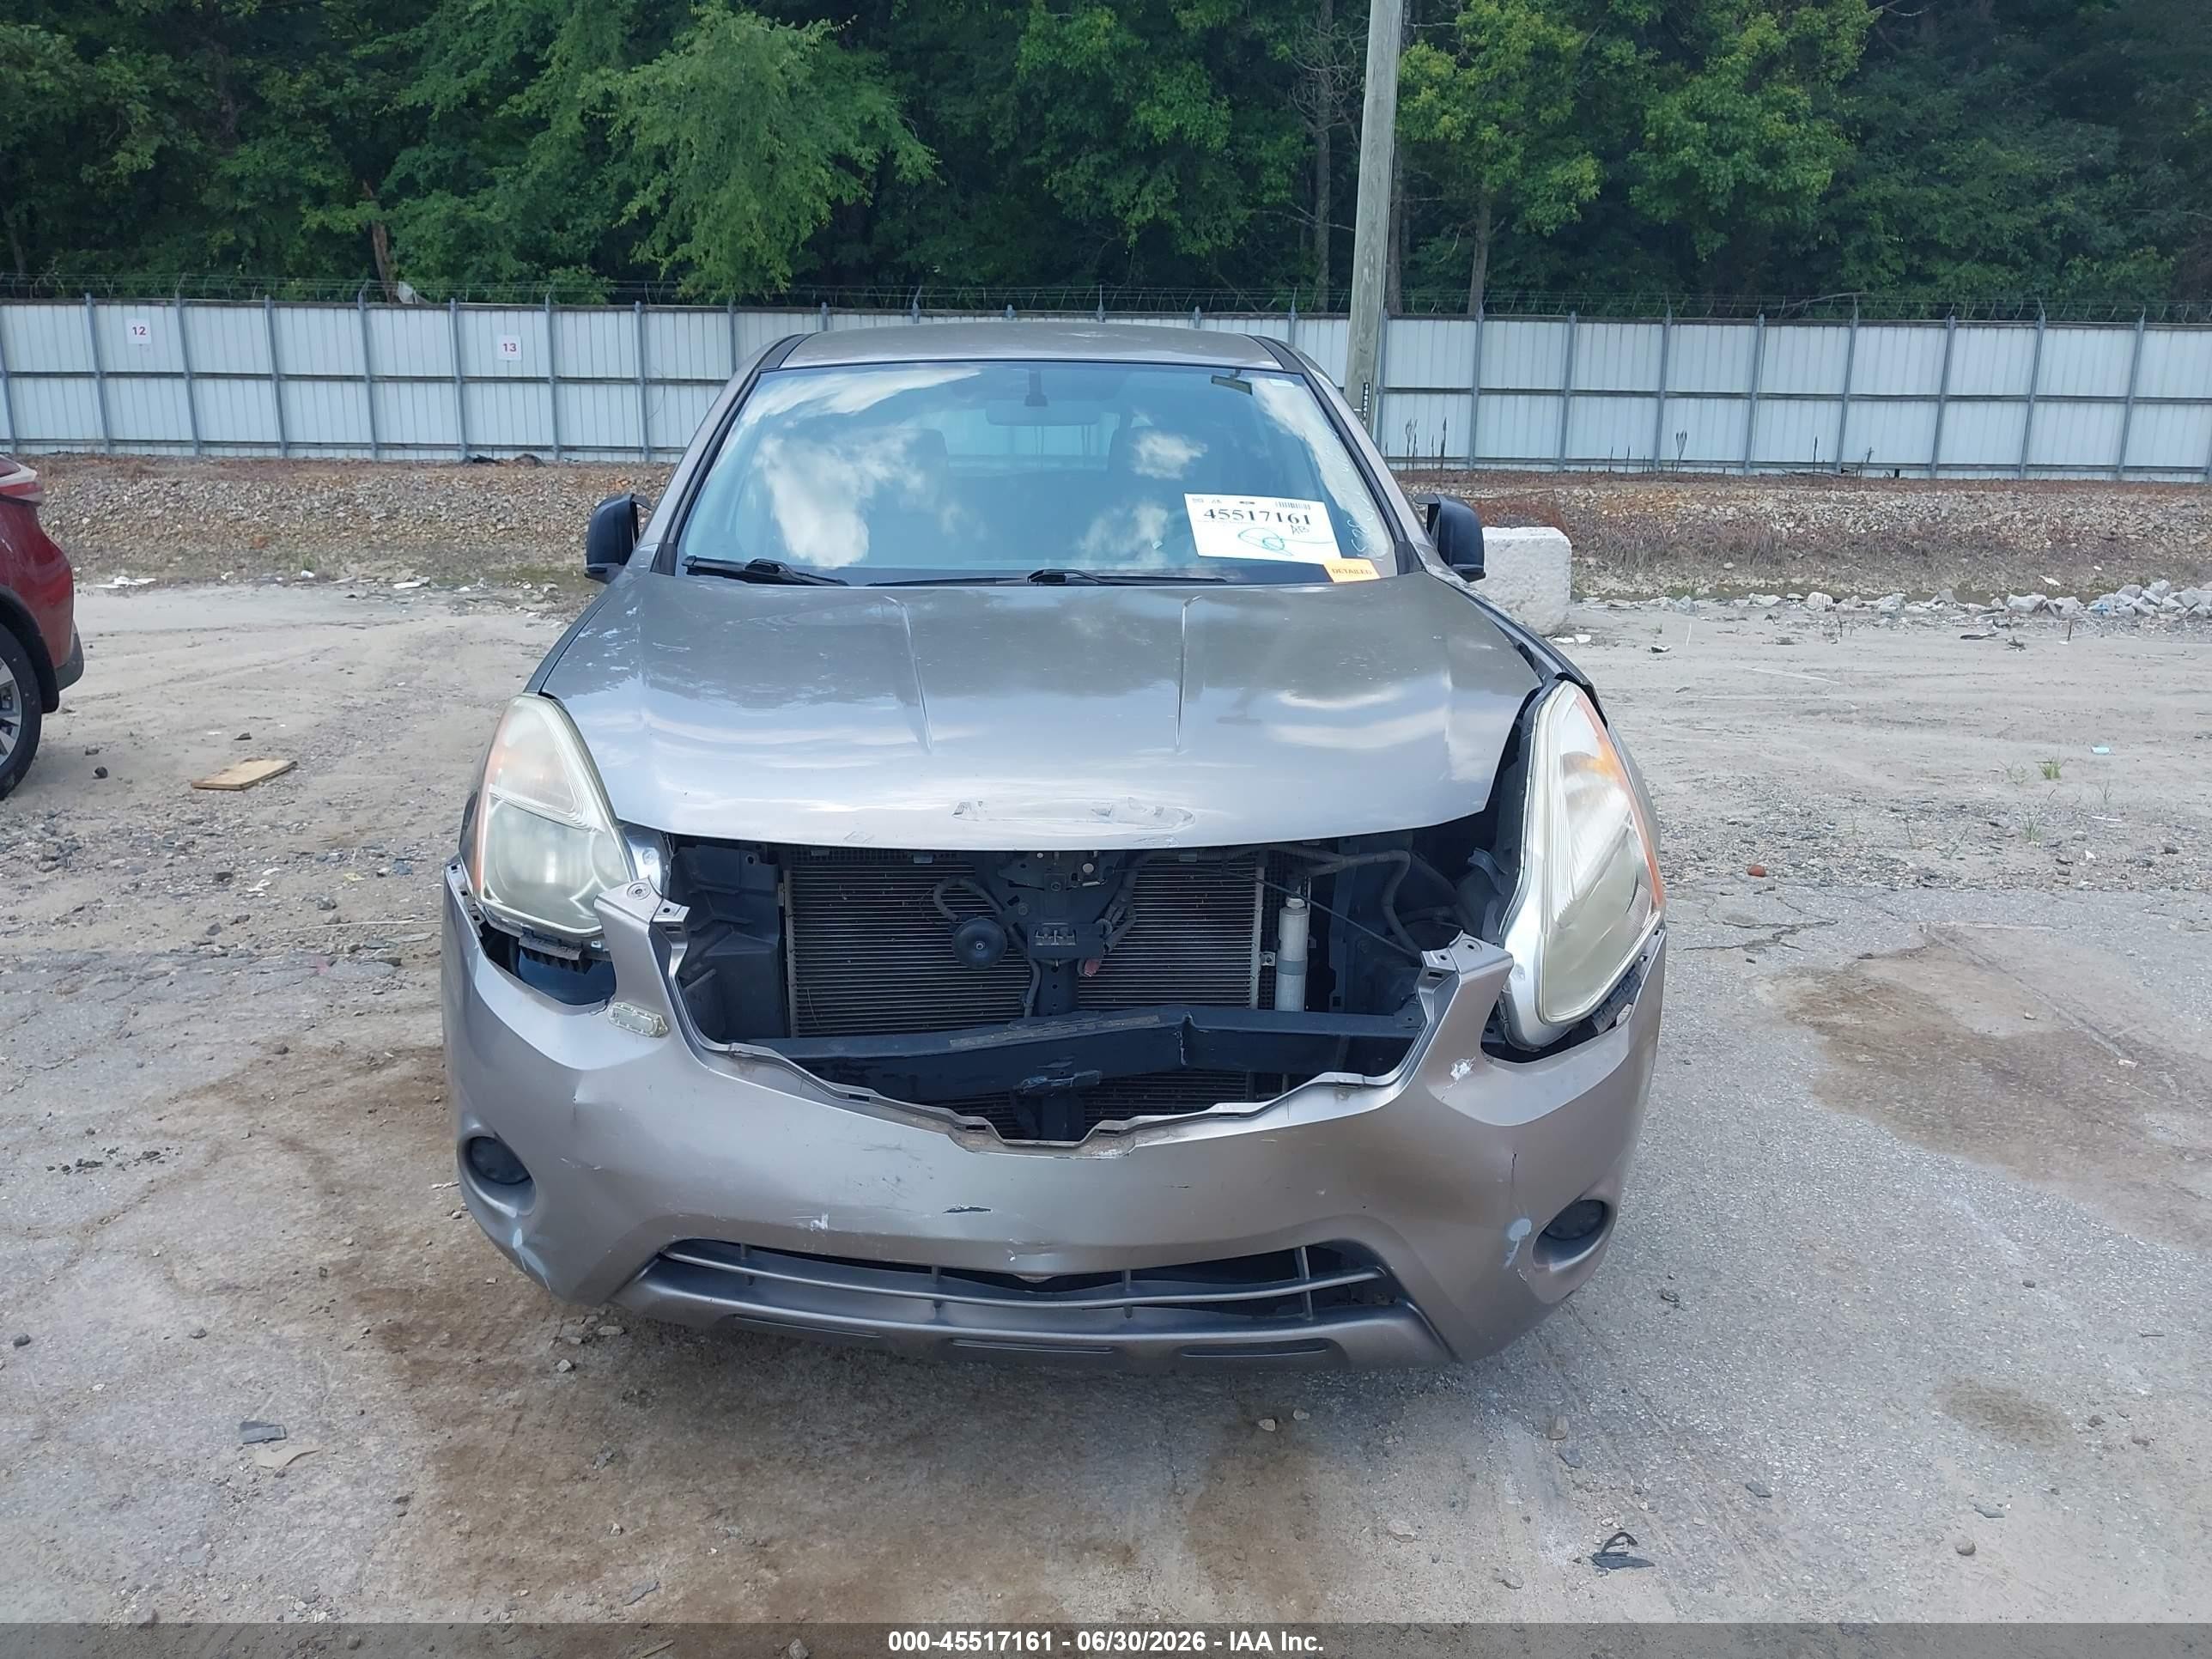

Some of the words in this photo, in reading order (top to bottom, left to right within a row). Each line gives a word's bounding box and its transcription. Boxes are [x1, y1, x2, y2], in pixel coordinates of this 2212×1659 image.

[132, 326, 146, 336] 12
[503, 343, 517, 352] 13
[1204, 508, 1311, 525] 45517161
